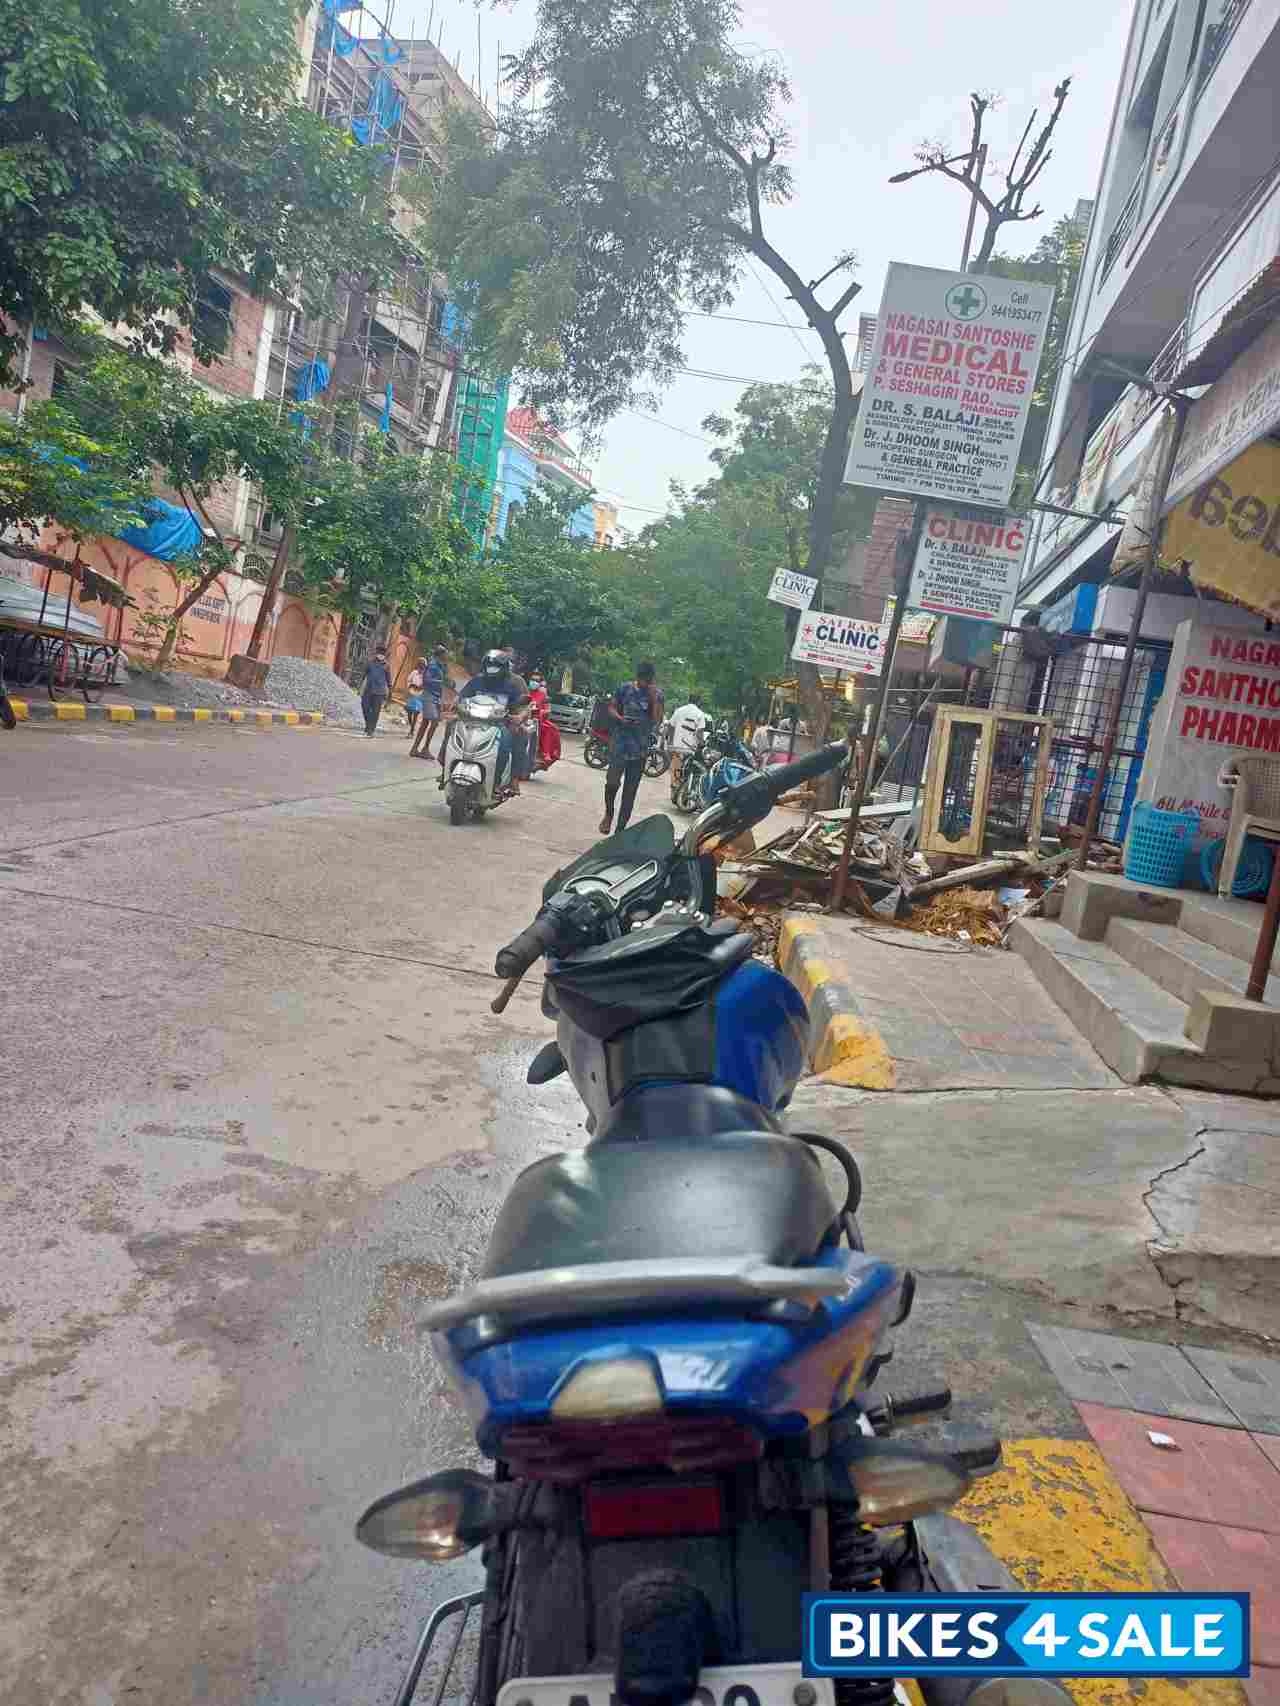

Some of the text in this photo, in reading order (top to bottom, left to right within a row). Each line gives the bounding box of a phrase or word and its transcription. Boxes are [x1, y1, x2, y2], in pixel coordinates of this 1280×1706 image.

[885, 312, 1037, 351] NAGASAI SANTOSHIE
[880, 331, 1031, 377] MEDICAL
[877, 359, 1026, 394] & GENERAL STORES
[888, 378, 959, 400] SESHAGIRI
[871, 398, 898, 413] DR.
[902, 402, 918, 416] S.
[922, 405, 980, 427] BALAJI
[896, 432, 940, 449] DHOOM
[942, 439, 980, 456] SINGH
[890, 454, 934, 469] GENERAL
[935, 461, 983, 477] PRACTICE
[926, 516, 1025, 551] CLINIC
[775, 576, 815, 597] CLINIC
[816, 625, 879, 650] CLINIC
